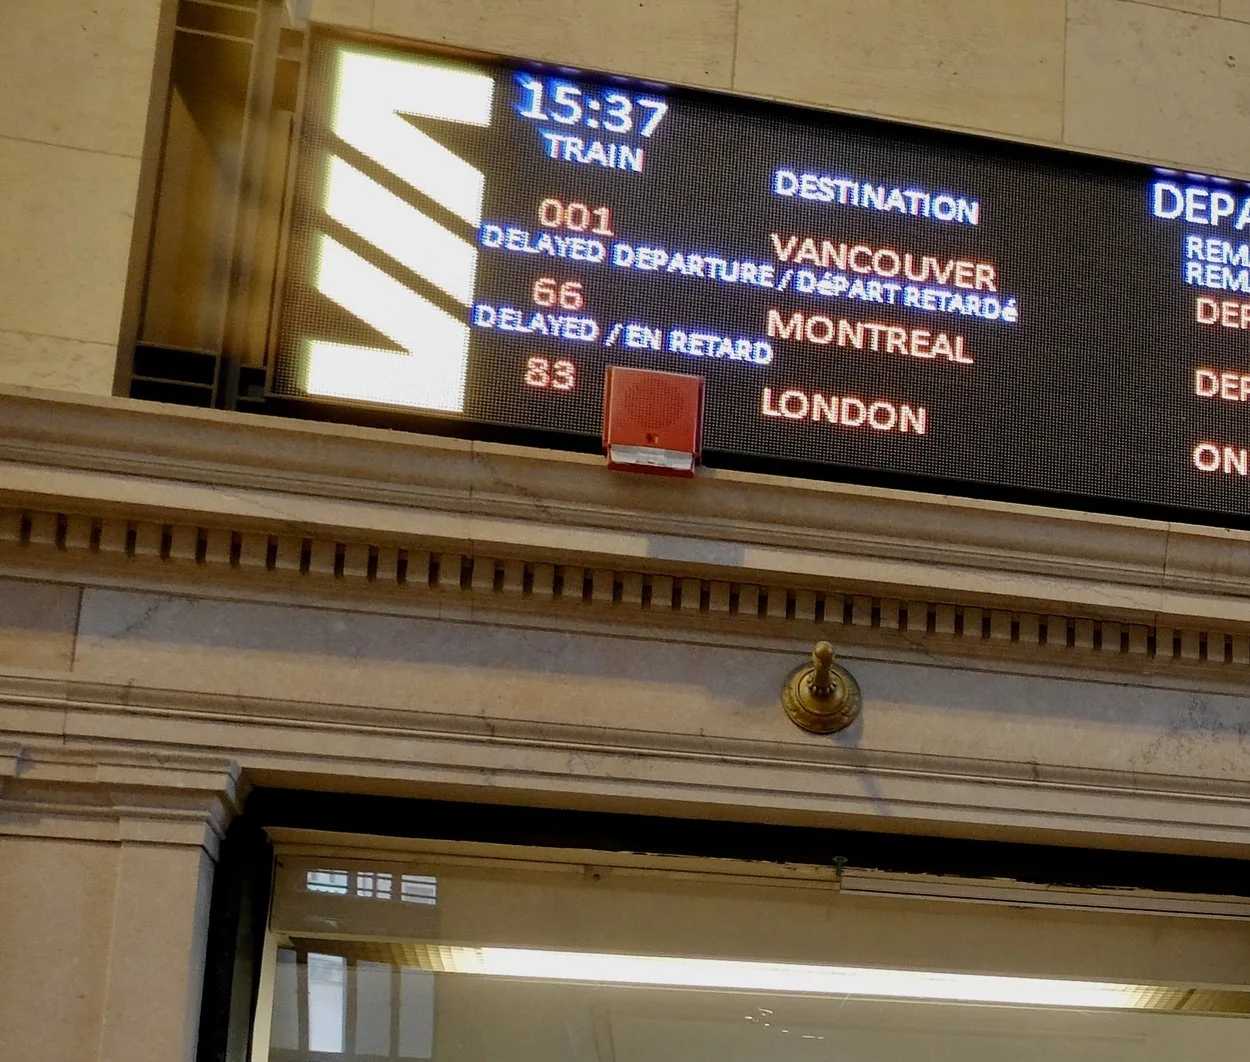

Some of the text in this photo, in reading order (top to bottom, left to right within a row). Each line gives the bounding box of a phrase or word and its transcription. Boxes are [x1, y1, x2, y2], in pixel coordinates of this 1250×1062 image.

[515, 72, 668, 138] 15:37
[542, 132, 646, 172] TRAIN
[537, 197, 615, 237] 001
[771, 168, 982, 226] DESTINATION
[480, 224, 605, 264] DELAYED
[612, 244, 774, 288] DEPARTURE
[770, 231, 998, 293] VANCOUVER
[532, 277, 584, 312] 66
[473, 302, 598, 343] DELAYED
[624, 325, 661, 350] EN
[669, 331, 774, 365] RETARD
[766, 310, 975, 365] MONTREAL
[523, 357, 576, 390] 83
[762, 387, 928, 434] LONDON
[1193, 443, 1247, 476] ON
